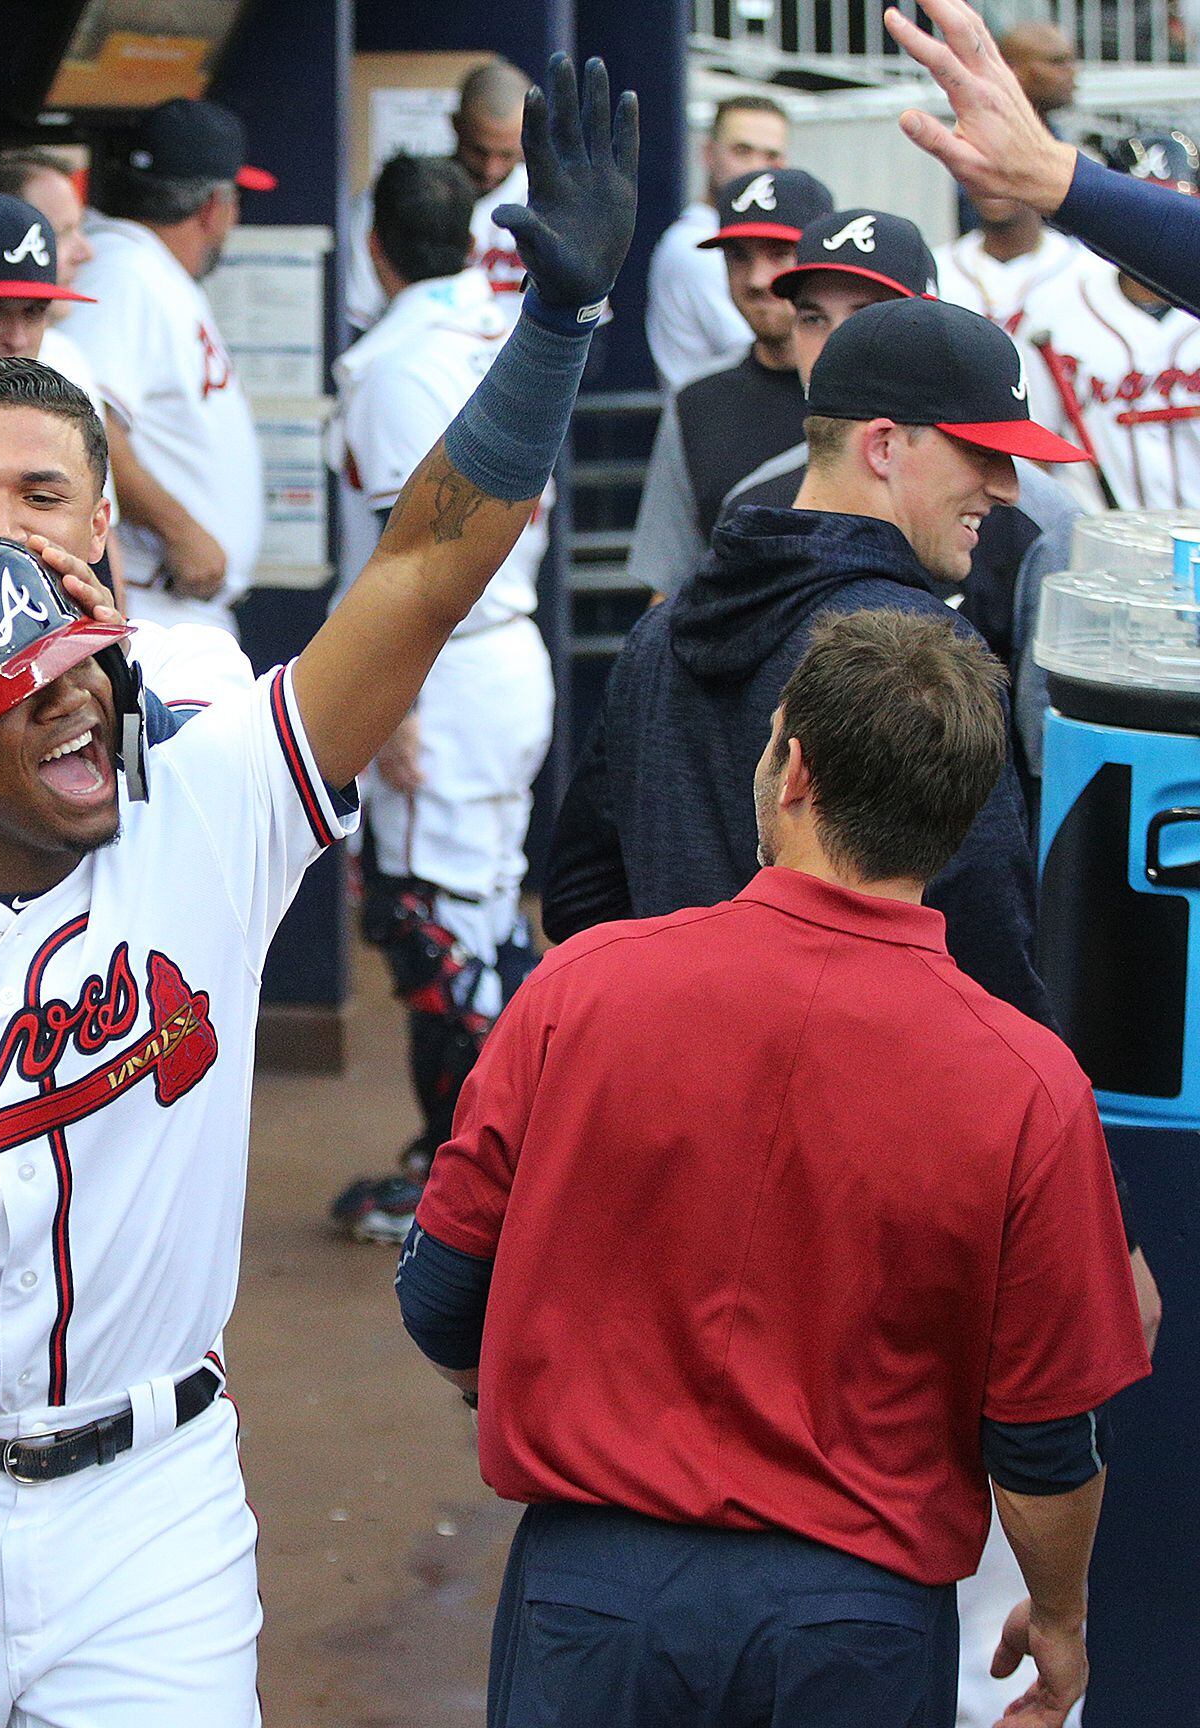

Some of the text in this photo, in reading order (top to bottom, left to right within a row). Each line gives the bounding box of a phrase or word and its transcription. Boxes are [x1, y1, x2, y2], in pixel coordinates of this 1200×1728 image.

[731, 173, 777, 213] A
[3, 222, 50, 267] A
[822, 215, 876, 253] A
